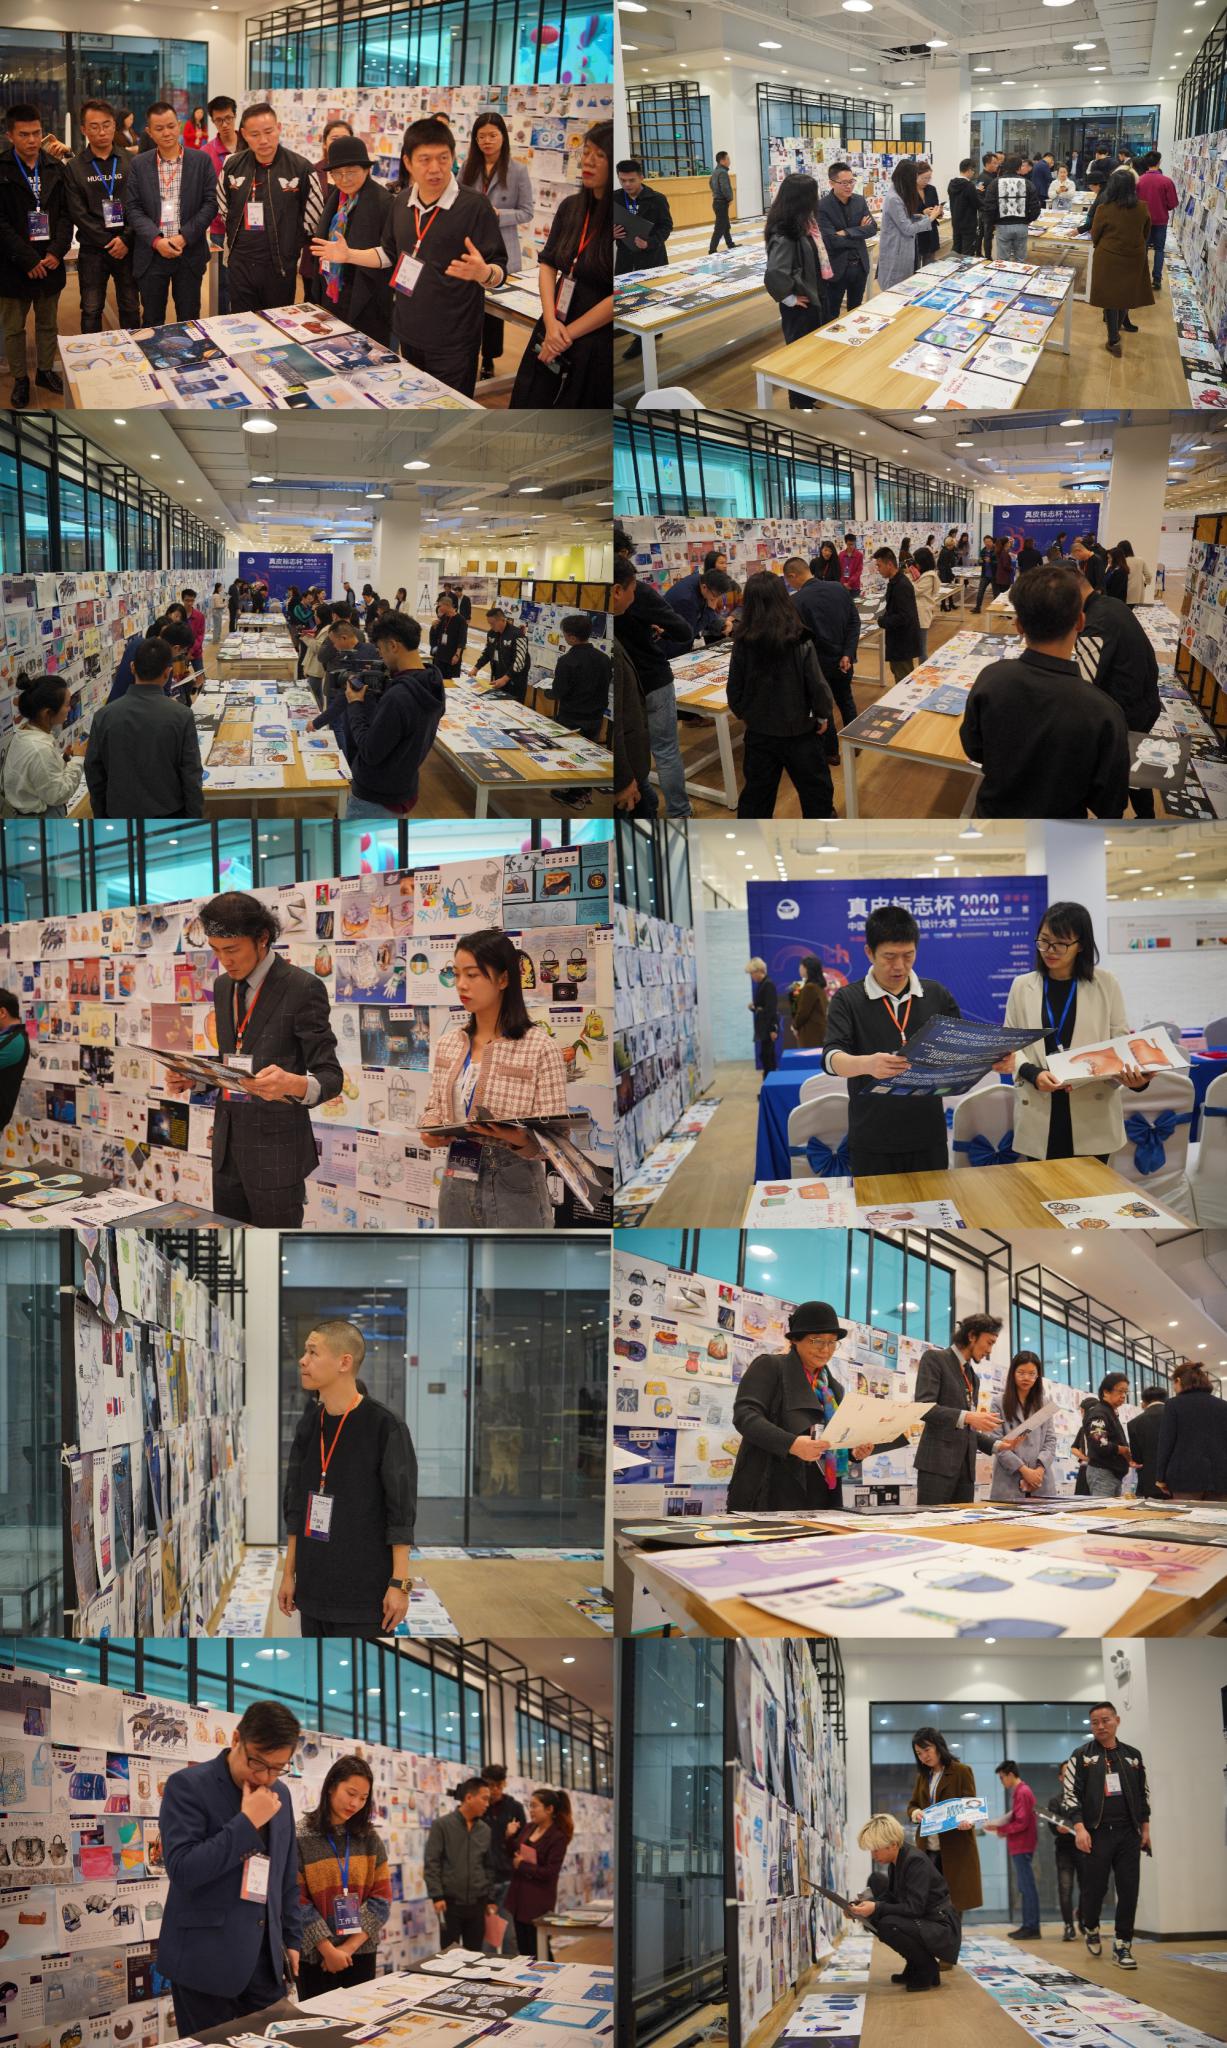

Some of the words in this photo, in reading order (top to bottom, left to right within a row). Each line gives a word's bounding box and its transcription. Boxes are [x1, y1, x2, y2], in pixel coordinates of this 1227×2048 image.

[847, 895, 956, 919] 真皮标志杯
[960, 893, 999, 916] 2020
[452, 1155, 478, 1168] 工作证
[338, 1916, 360, 1926] 工作证
